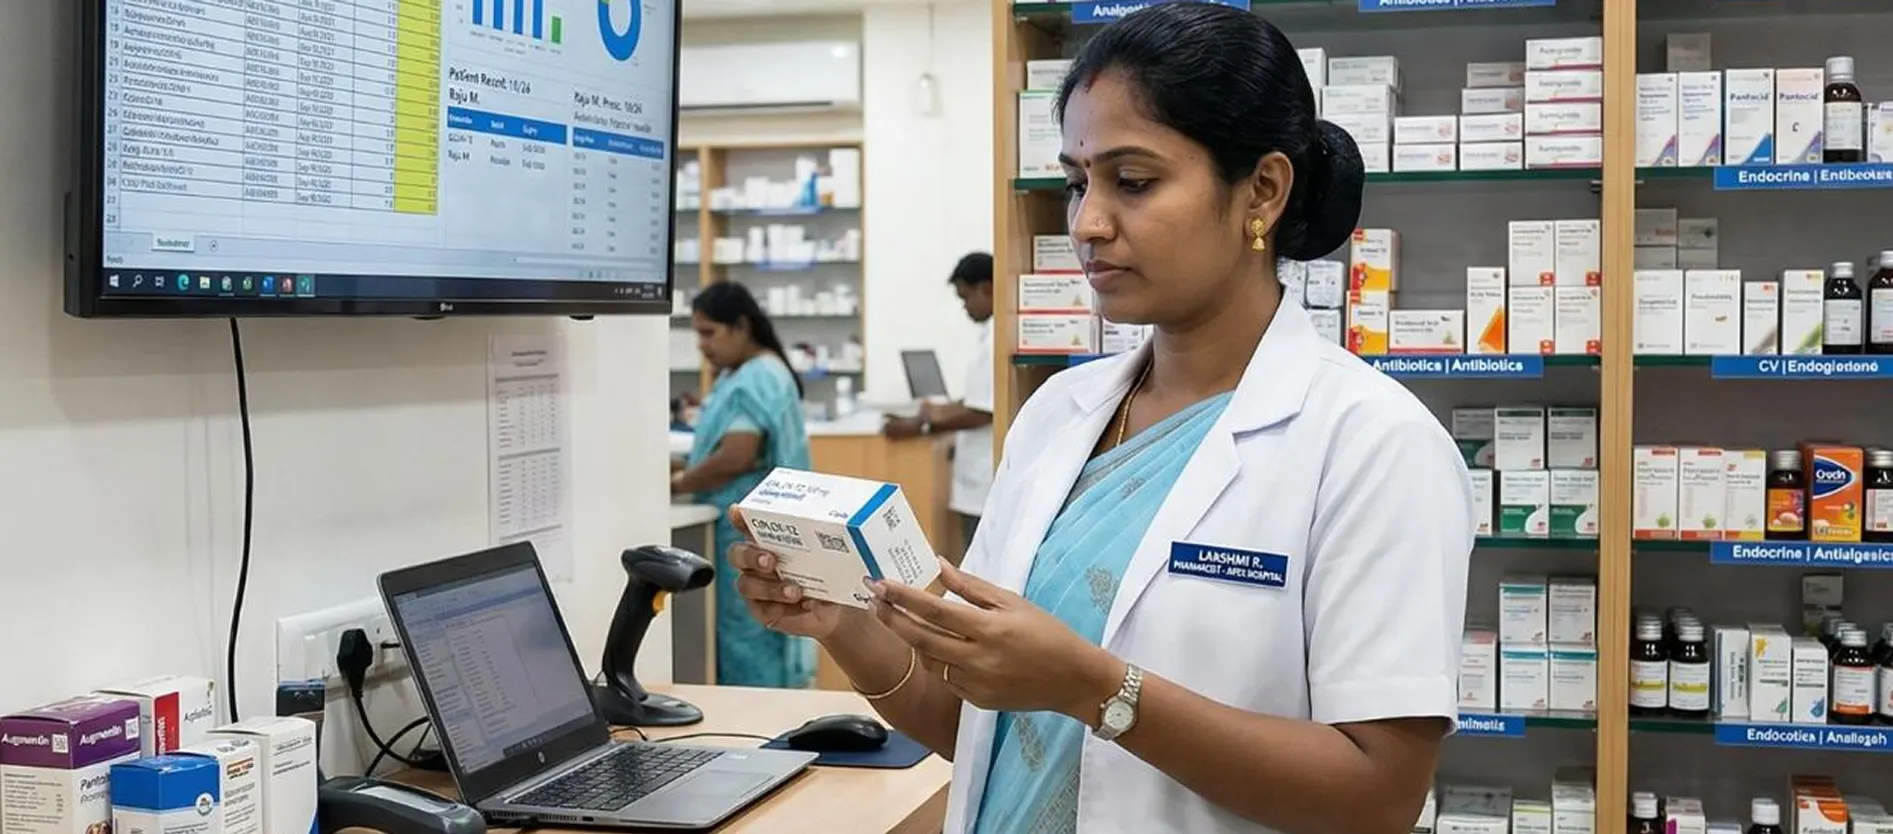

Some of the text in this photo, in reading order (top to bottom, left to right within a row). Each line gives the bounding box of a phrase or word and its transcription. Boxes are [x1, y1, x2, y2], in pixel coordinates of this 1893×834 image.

[1739, 170, 1810, 183] Endocrine
[1373, 358, 1442, 372] Antibiotics
[1452, 358, 1524, 372] Antibiotics
[1759, 360, 1779, 373] CV
[1733, 546, 1802, 558] Endocrine
[1252, 556, 1263, 569] R.
